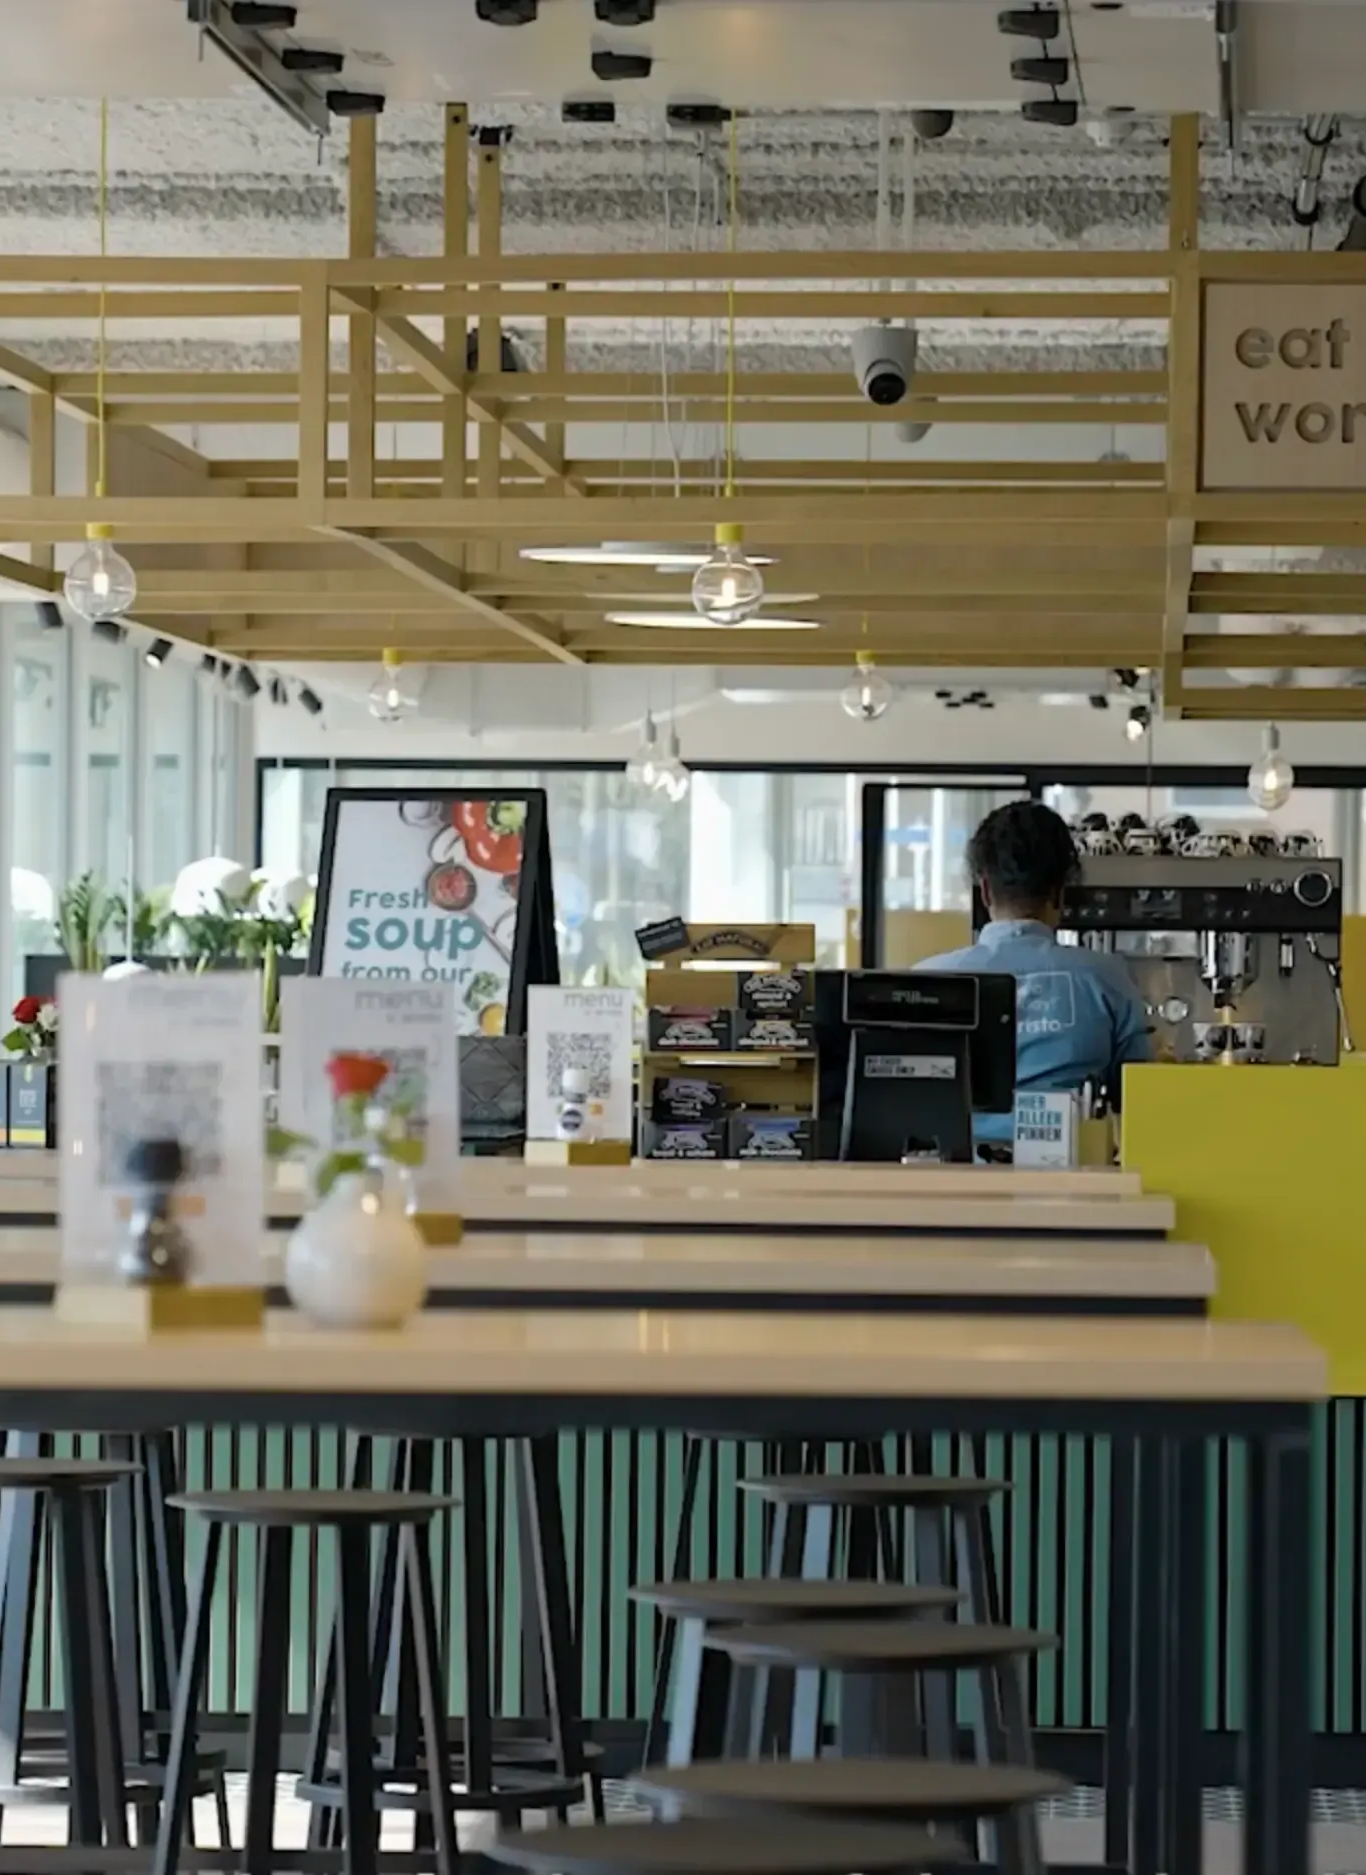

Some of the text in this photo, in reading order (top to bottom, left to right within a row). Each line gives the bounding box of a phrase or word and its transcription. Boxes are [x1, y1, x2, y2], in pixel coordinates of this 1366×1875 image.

[1235, 318, 1350, 370] eat
[348, 887, 429, 910] Fresh
[344, 916, 483, 961] soup
[341, 961, 473, 984] from our
[563, 991, 624, 1008] menu
[1017, 1095, 1046, 1109] HIER
[1016, 1110, 1063, 1125] ALLEEN
[1016, 1127, 1063, 1141] PINNEN
